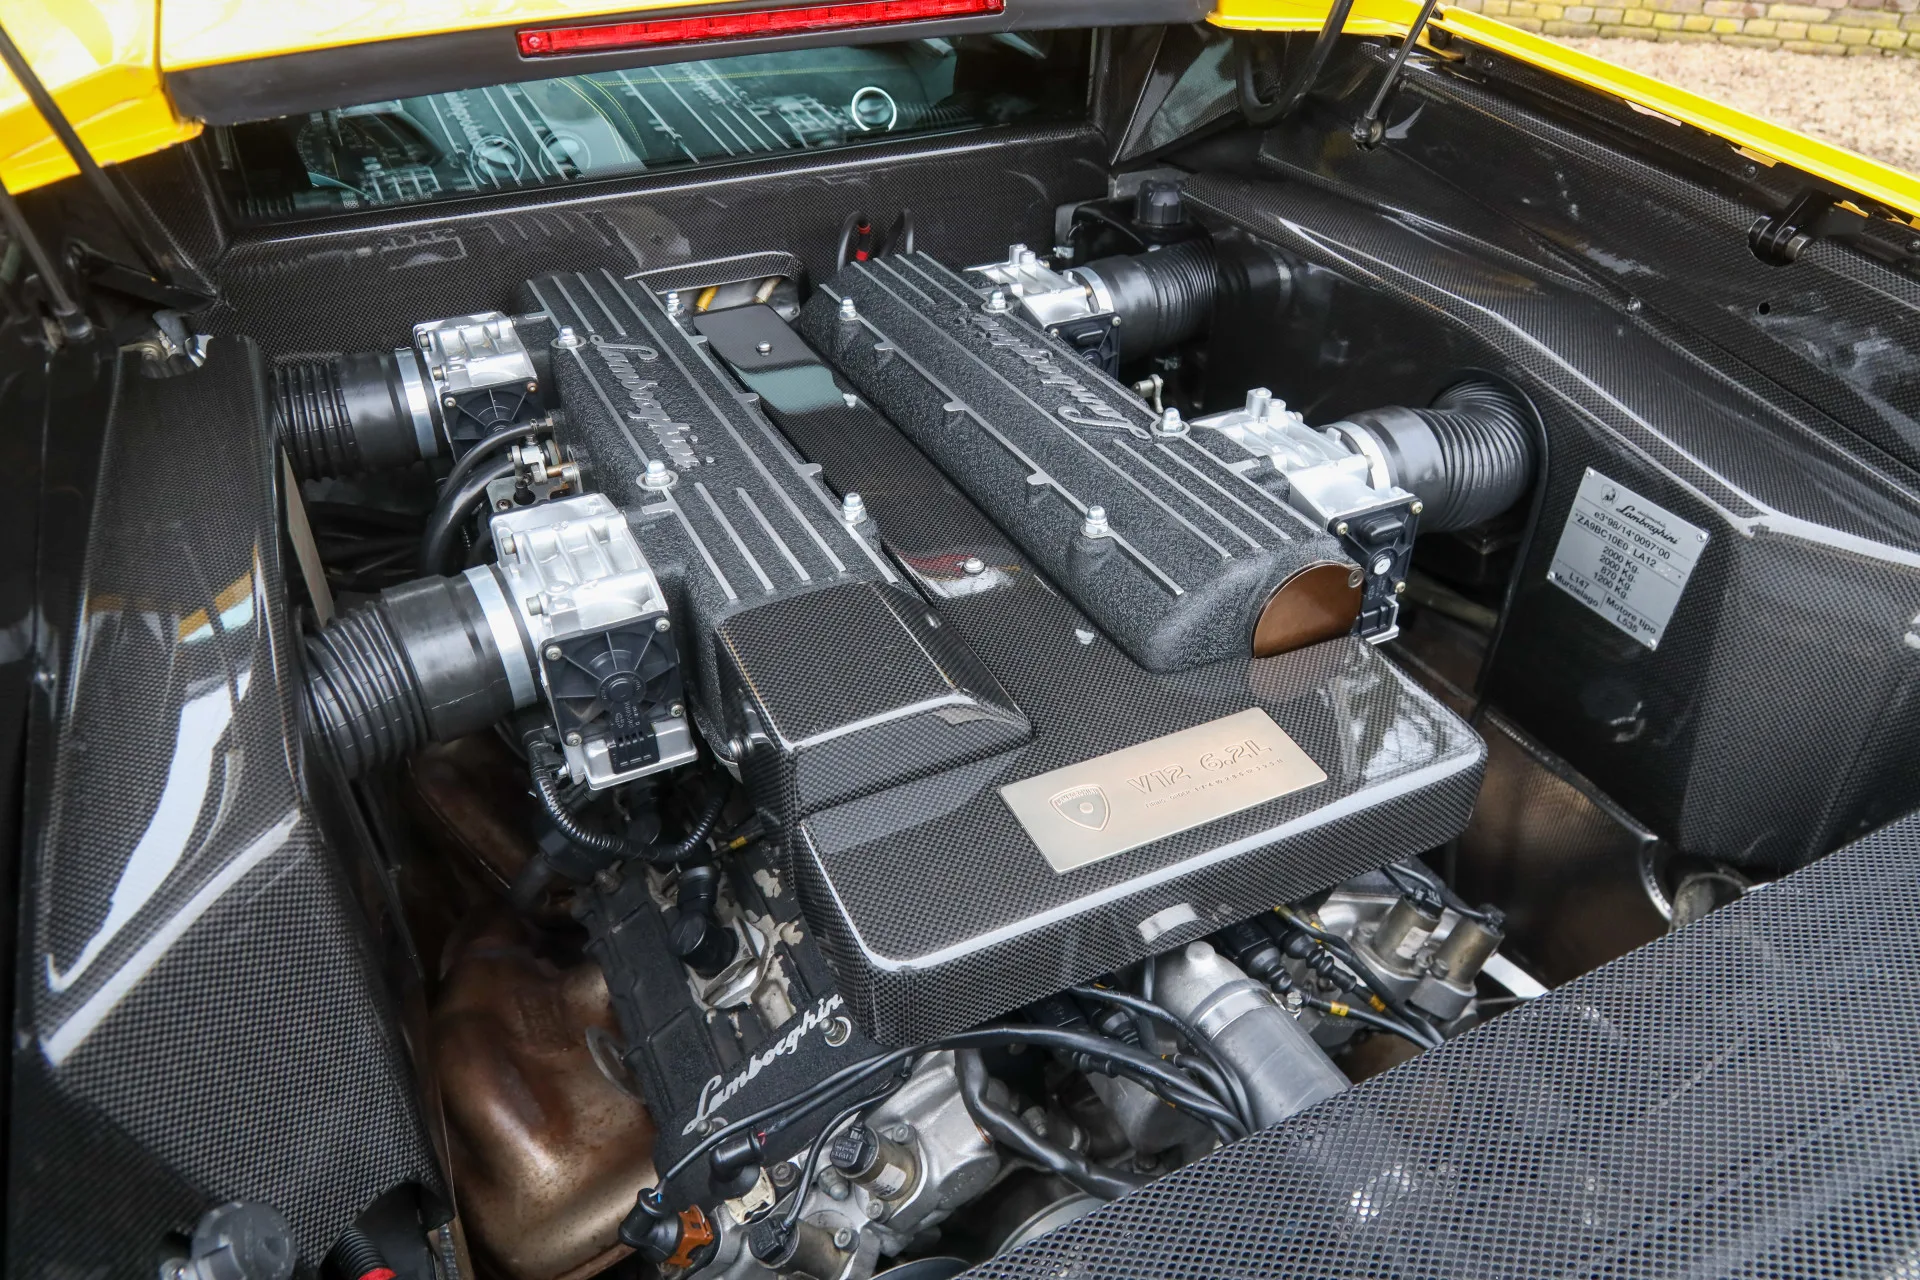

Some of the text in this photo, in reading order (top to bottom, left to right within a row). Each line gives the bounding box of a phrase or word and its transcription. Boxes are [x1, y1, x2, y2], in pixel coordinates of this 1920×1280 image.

[957, 313, 1152, 440] Lamborghini
[590, 335, 714, 472] Lamborghini
[1616, 505, 1682, 545] Lamborghini
[1599, 555, 1636, 583] 2000 Kg.
[1602, 546, 1640, 574] 2000 Kg.
[1569, 572, 1590, 590] L147
[1593, 571, 1628, 600] 1200 Kg.
[1600, 566, 1632, 591] 870 Kg.
[1605, 596, 1657, 635] Motore tipo
[1616, 613, 1638, 633] L535
[1126, 739, 1272, 795] V12 6.2L
[682, 993, 844, 1136] Lamborghin
